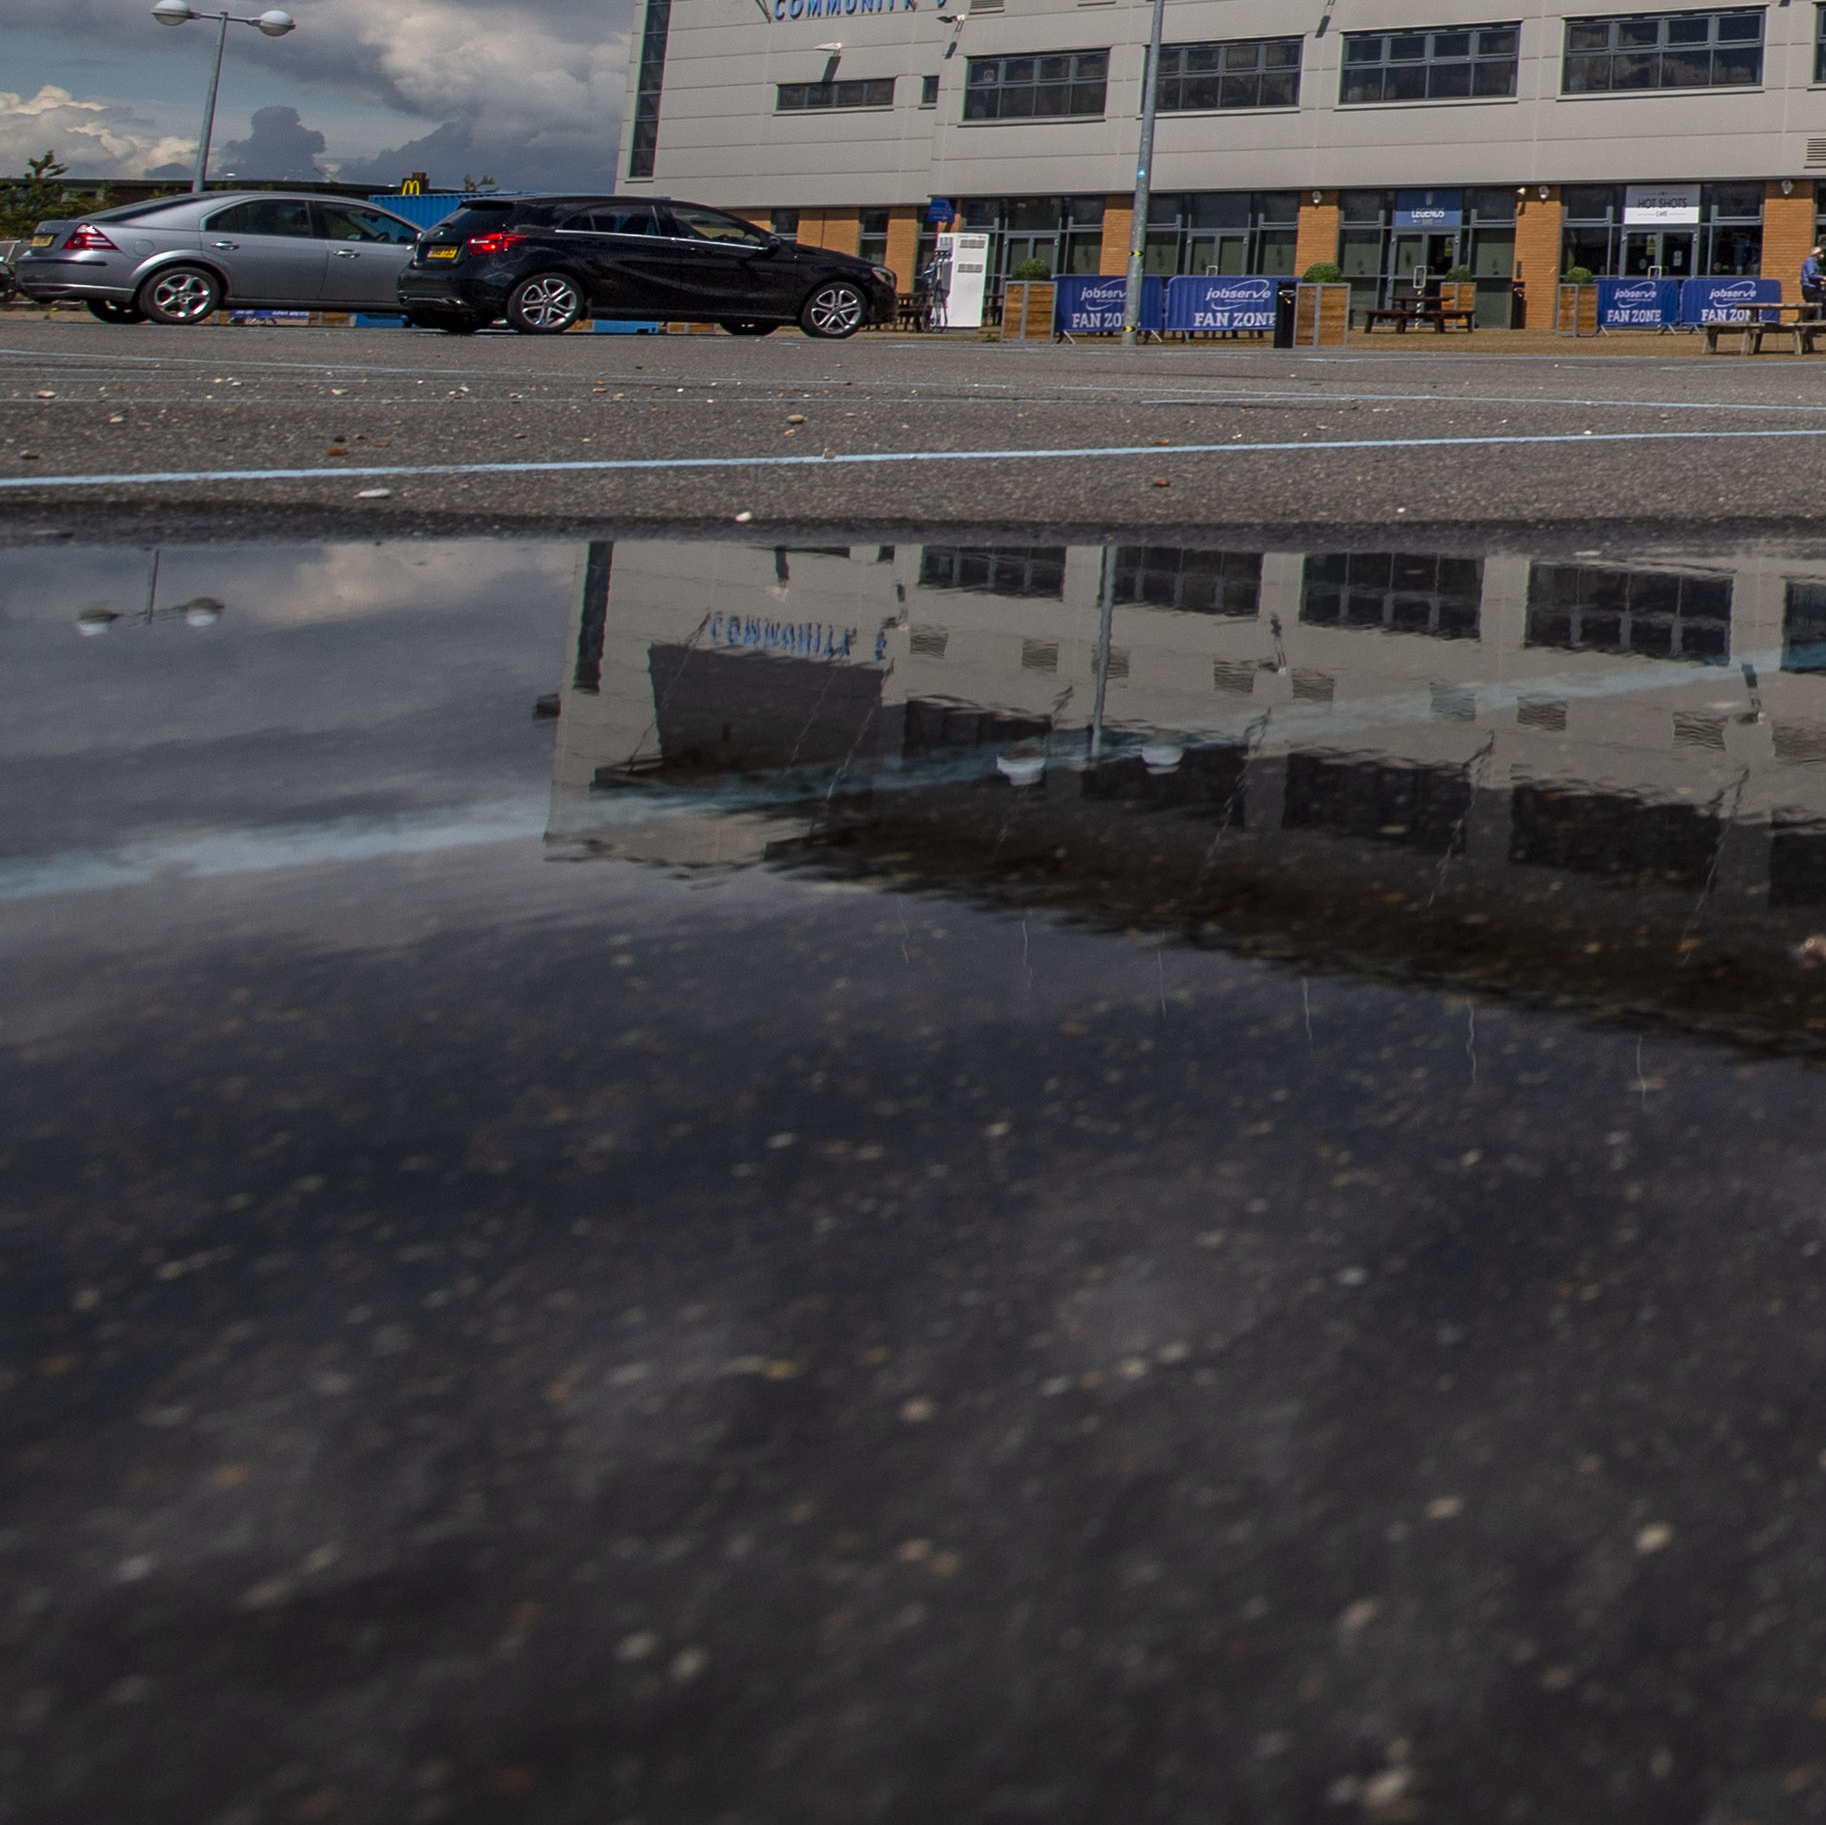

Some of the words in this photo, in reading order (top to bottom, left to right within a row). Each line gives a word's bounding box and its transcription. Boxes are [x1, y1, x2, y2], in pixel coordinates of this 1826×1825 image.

[1658, 197, 1688, 209] SHOTS
[1080, 287, 1127, 301] jobserv
[1205, 288, 1272, 301] jobserve
[1613, 288, 1657, 300] jobserve
[1708, 288, 1757, 300] jobserve
[1072, 313, 1102, 328] FAN
[1103, 313, 1125, 327] ZO
[1193, 312, 1230, 327] FAN
[1232, 312, 1277, 327] ZONE
[1606, 309, 1631, 323] FAN
[1631, 309, 1662, 323] ZONE
[1701, 309, 1728, 321] FAN
[1729, 309, 1762, 321] ZON
